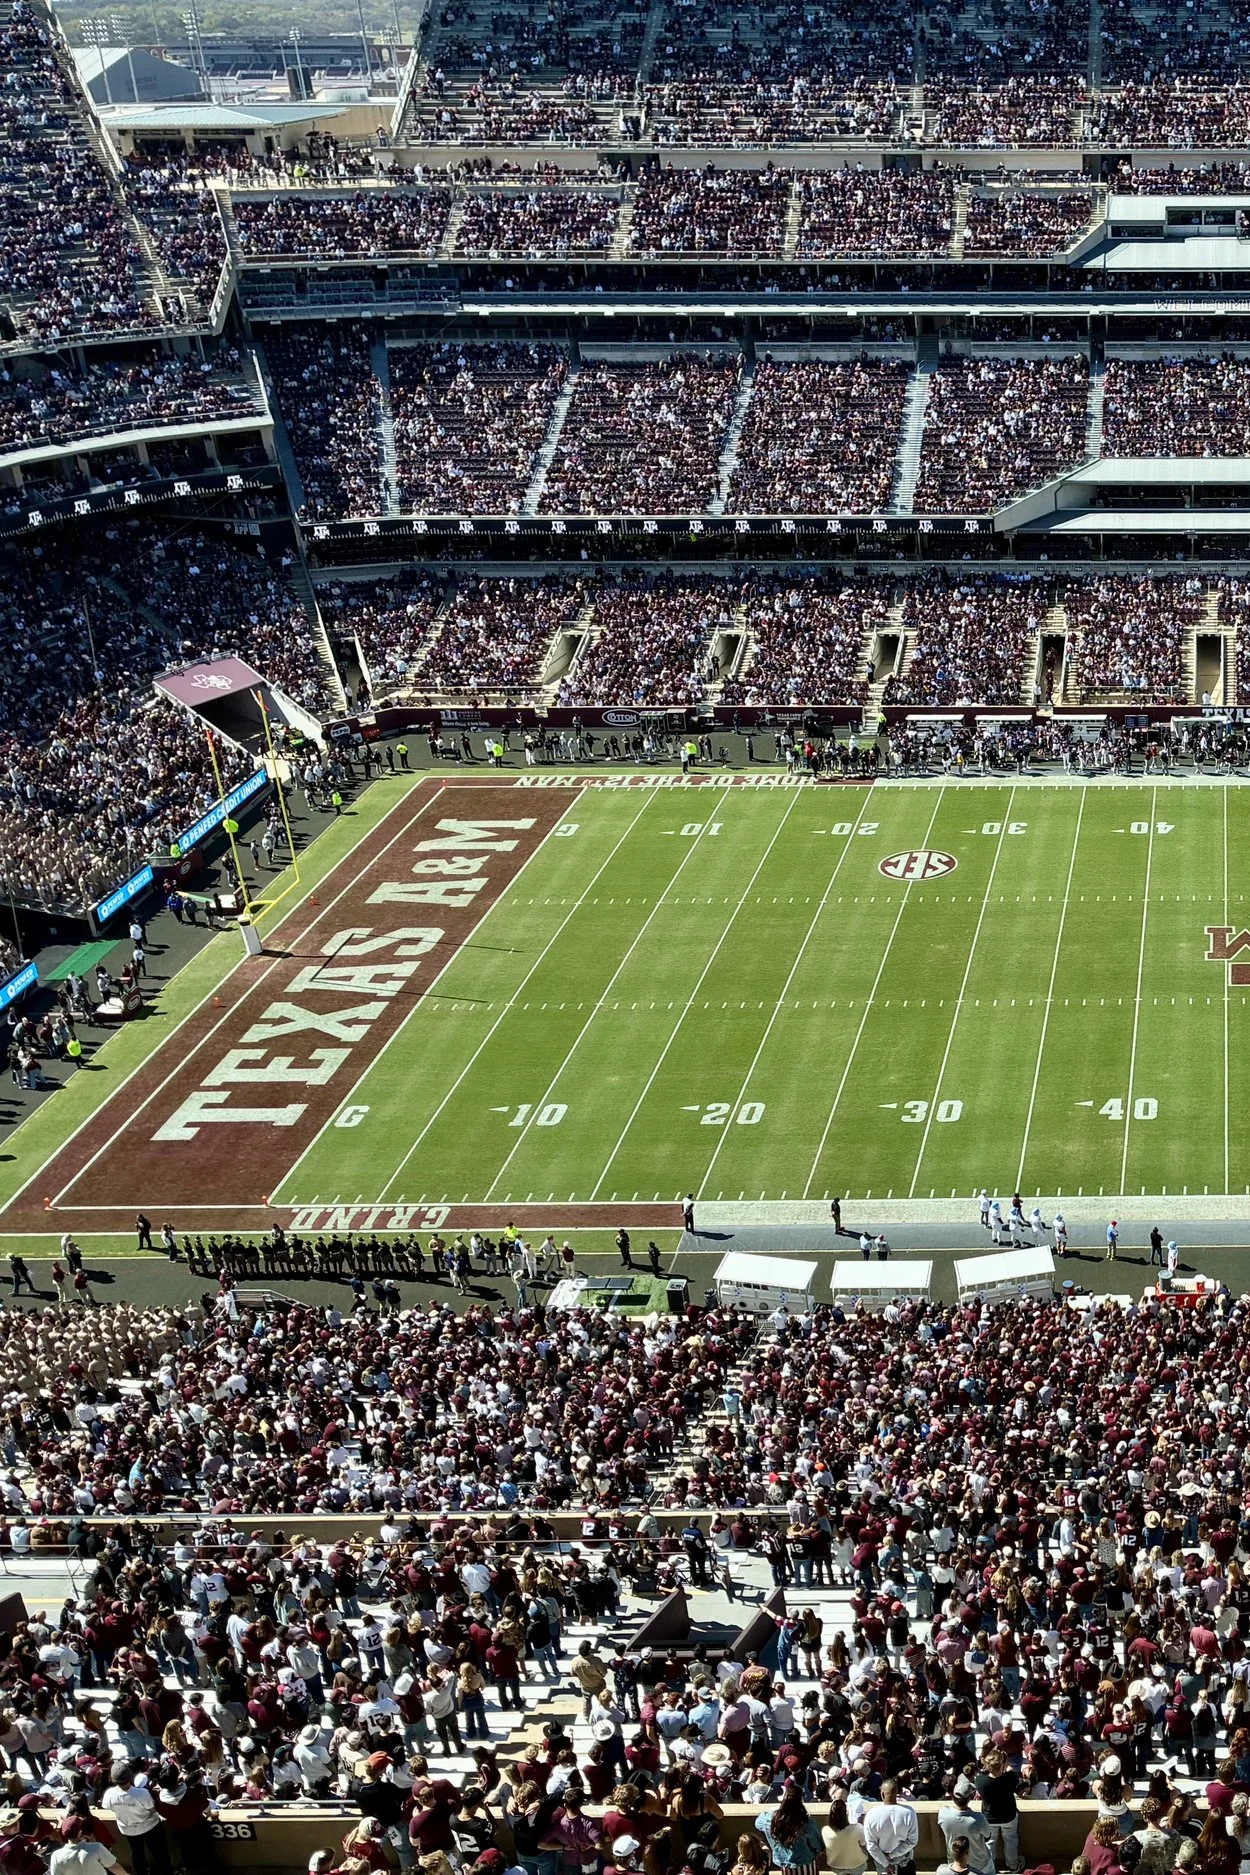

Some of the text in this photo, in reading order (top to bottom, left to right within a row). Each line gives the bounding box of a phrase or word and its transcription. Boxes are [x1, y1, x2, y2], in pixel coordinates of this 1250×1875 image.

[332, 727, 350, 736] PEPSI
[517, 777, 577, 786] MAN
[640, 776, 693, 786] THE
[699, 776, 734, 785] OF
[189, 775, 264, 839] PENFED UNION
[554, 823, 579, 836] G
[680, 823, 724, 836] 10
[831, 822, 880, 836] 20
[981, 822, 1027, 835] 30
[1130, 821, 1175, 835] 40
[884, 852, 952, 878] SEC
[151, 817, 537, 1142] TEXAS A&M
[509, 1103, 568, 1127] 10
[700, 1102, 765, 1125] 20
[901, 1100, 964, 1123] 30
[1098, 1097, 1159, 1121] 40
[334, 1105, 370, 1128] G
[39, 1413, 50, 1424] 12
[1064, 1495, 1076, 1507] 12
[1112, 1500, 1122, 1511] 12
[143, 1524, 160, 1532] 37
[583, 1522, 594, 1536] 12
[204, 1581, 217, 1592] 12
[252, 1583, 266, 1594] 12
[1235, 1590, 1248, 1601] 12
[367, 1633, 381, 1646] 12
[1096, 1635, 1109, 1647] 12
[212, 1823, 251, 1839] 336
